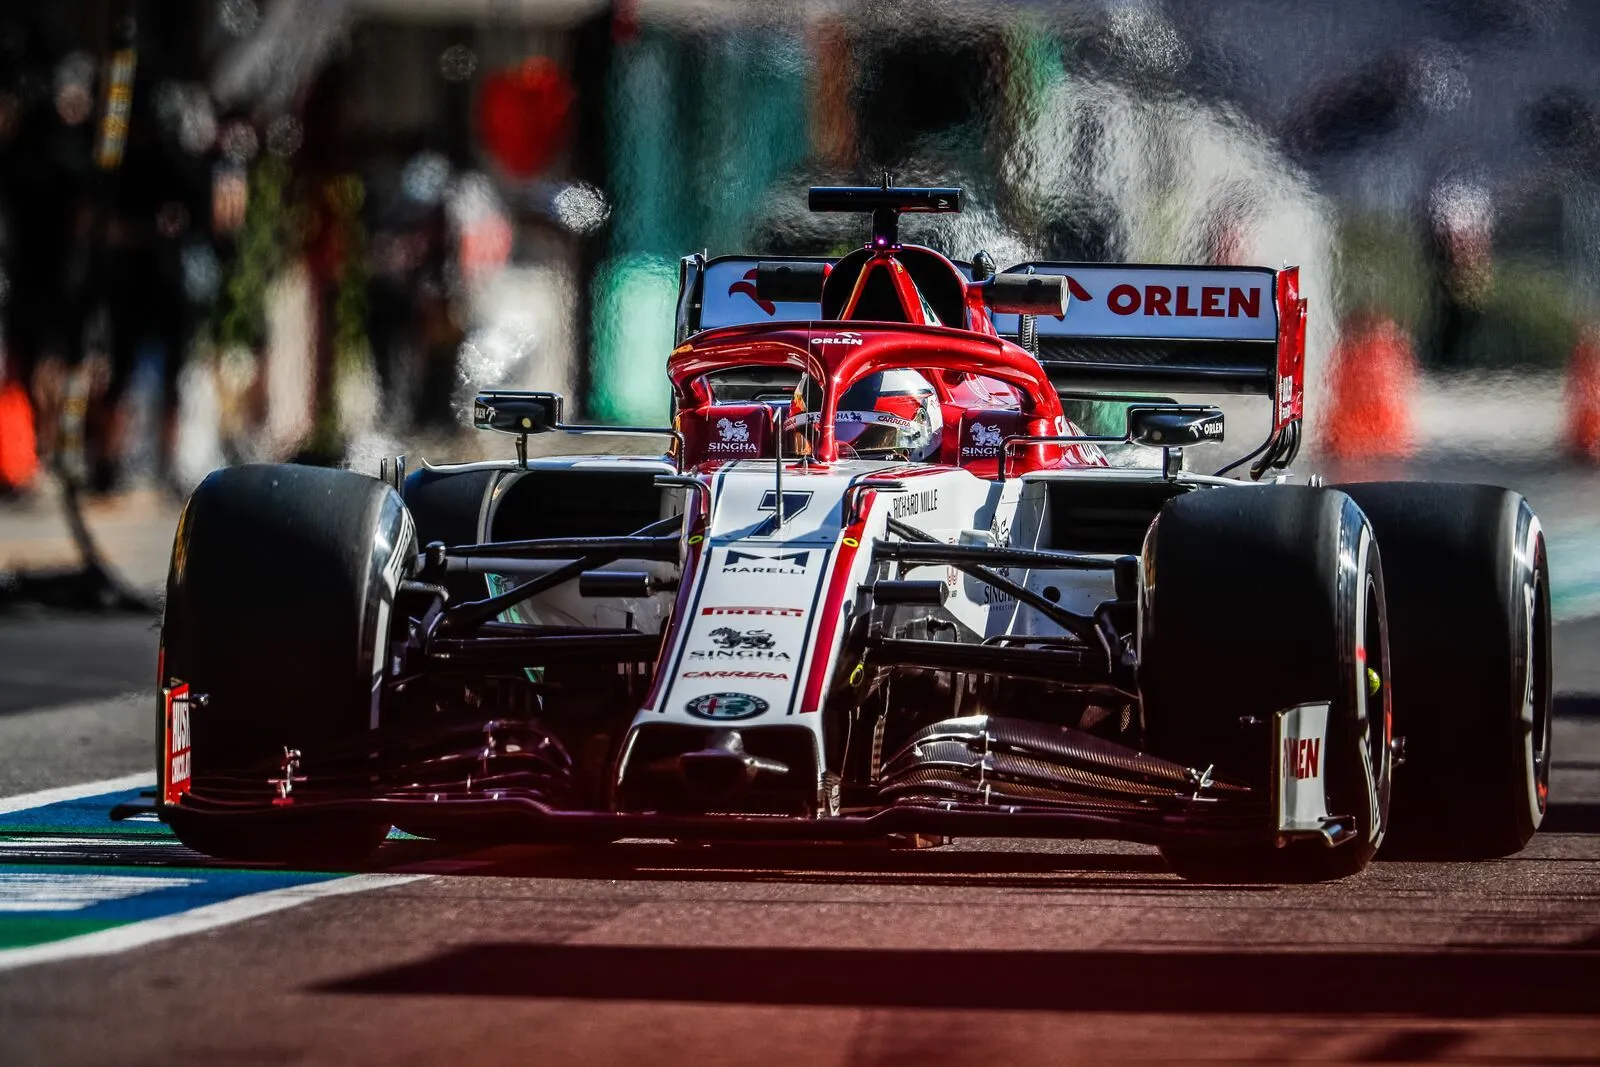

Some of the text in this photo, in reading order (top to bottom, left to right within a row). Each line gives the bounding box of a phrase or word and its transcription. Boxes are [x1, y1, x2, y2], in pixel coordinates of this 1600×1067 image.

[1107, 284, 1261, 318] ORLEN
[810, 338, 863, 346] ORLEN
[877, 415, 911, 427] CARRERA
[1204, 422, 1223, 435] ORLEN
[708, 442, 757, 450] SINGHA
[962, 446, 1003, 455] SINGH
[893, 489, 938, 520] RICHARD MILLE
[745, 490, 814, 539] 7
[722, 567, 806, 575] MARELLI
[984, 585, 1016, 605] SINGH
[690, 650, 791, 659] SINGHA
[682, 671, 789, 680] CARRERA
